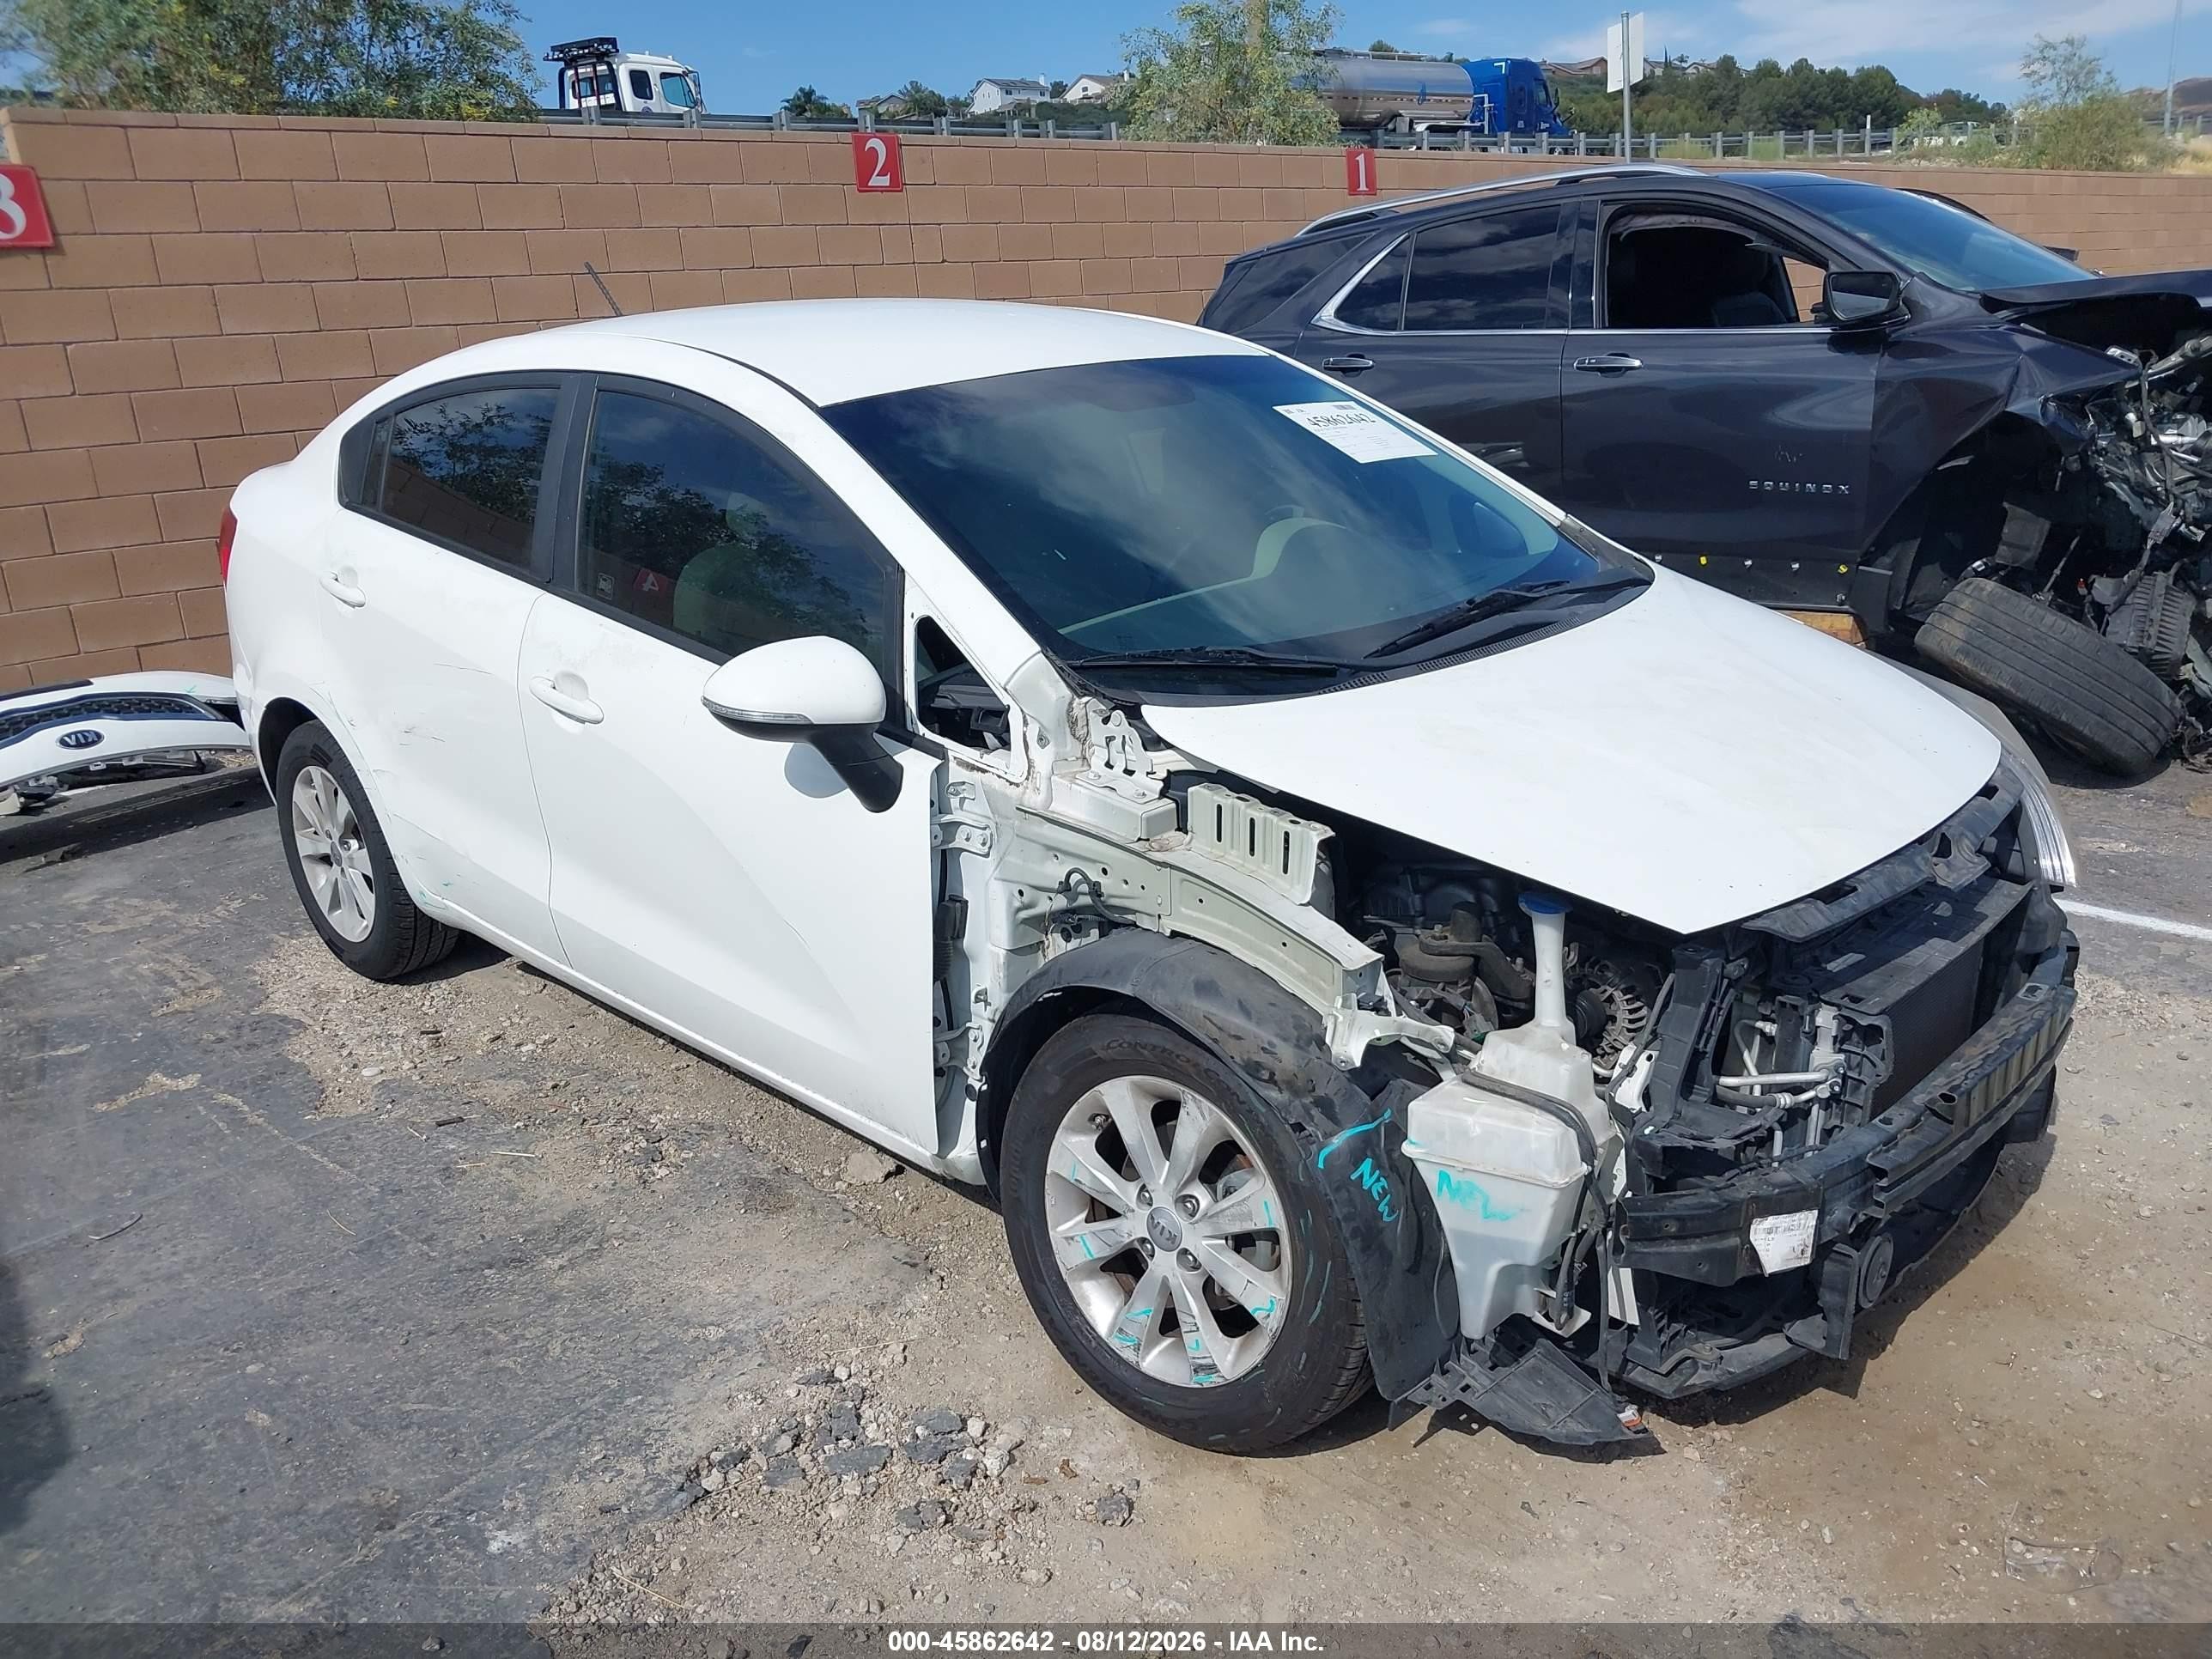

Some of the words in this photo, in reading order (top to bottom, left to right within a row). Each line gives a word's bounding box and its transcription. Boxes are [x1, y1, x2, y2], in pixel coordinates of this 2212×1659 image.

[865, 137, 890, 186] 2
[1355, 153, 1370, 191] 1
[1306, 413, 1376, 428] 45862642
[1748, 480, 1850, 495] EQUINOX
[63, 731, 98, 745] KIA
[1350, 1157, 1399, 1223] NEW
[1149, 1213, 1179, 1245] KIA
